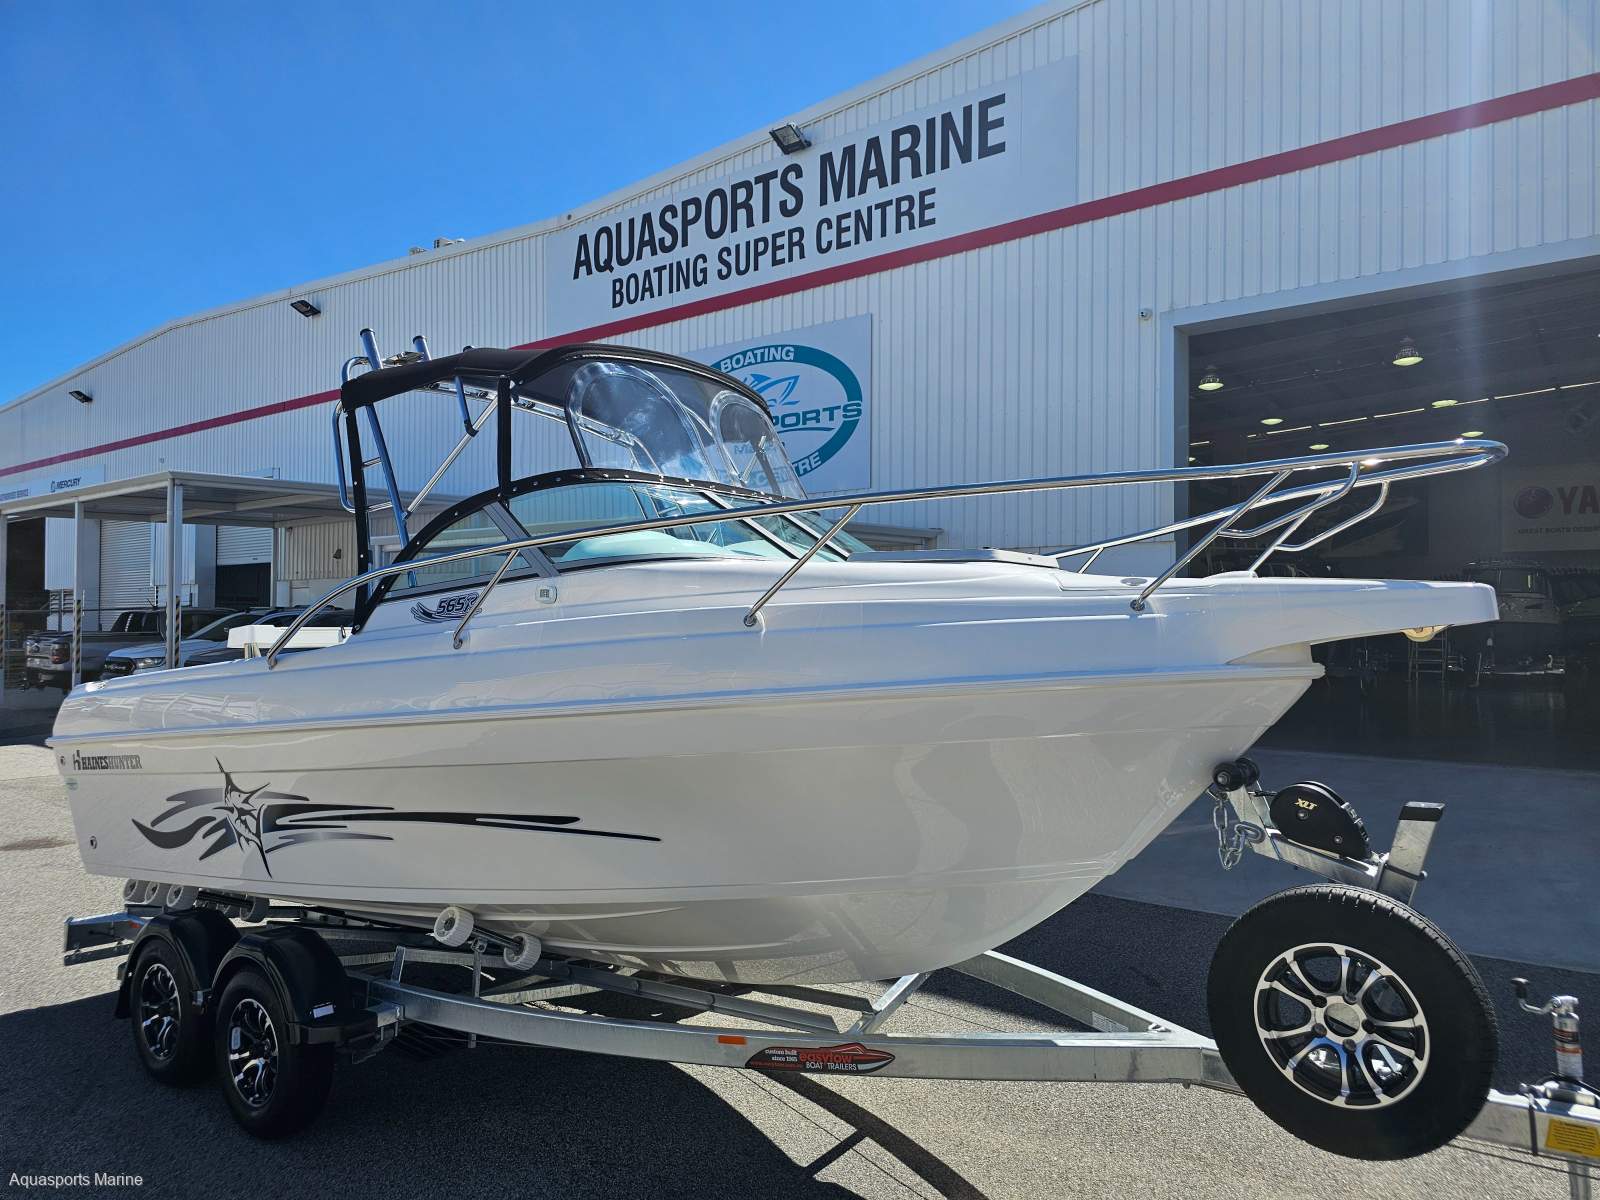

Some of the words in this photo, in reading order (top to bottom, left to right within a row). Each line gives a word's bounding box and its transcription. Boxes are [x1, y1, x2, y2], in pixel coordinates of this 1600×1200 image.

[573, 163, 804, 281] AQUASPORTS
[819, 93, 1006, 207] MARINE
[612, 252, 708, 309] BOATING
[717, 226, 805, 281] SUPER
[816, 187, 937, 254] CENTRE
[720, 346, 795, 374] BOATING
[772, 402, 863, 430] PORTS
[56, 477, 81, 490] MERCURY
[1294, 798, 1318, 810] XLT
[805, 1061, 823, 1070] BOAT
[827, 1062, 857, 1071] TRAILERS
